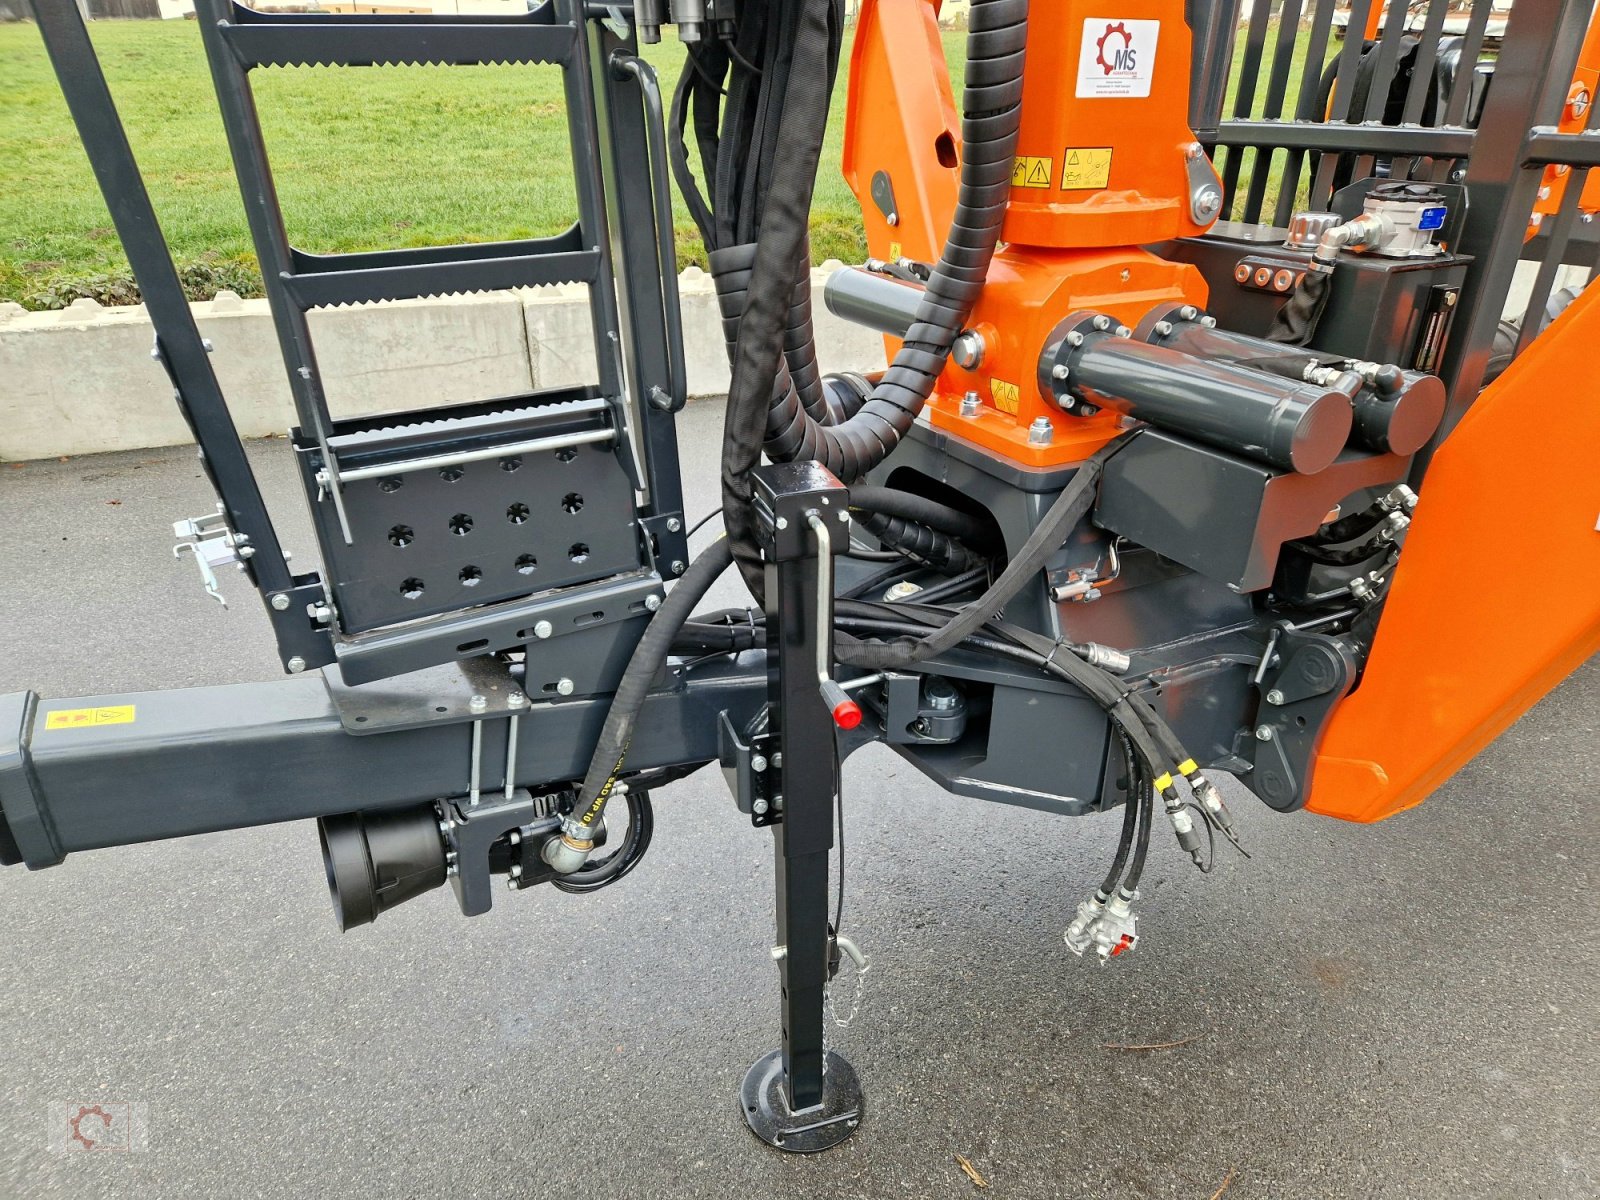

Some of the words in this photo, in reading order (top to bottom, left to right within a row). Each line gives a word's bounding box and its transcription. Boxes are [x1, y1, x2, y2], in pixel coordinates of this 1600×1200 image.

[1114, 49, 1137, 71] MS
[601, 776, 615, 796] S&D
[592, 797, 604, 811] WP
[583, 812, 594, 822] 10
